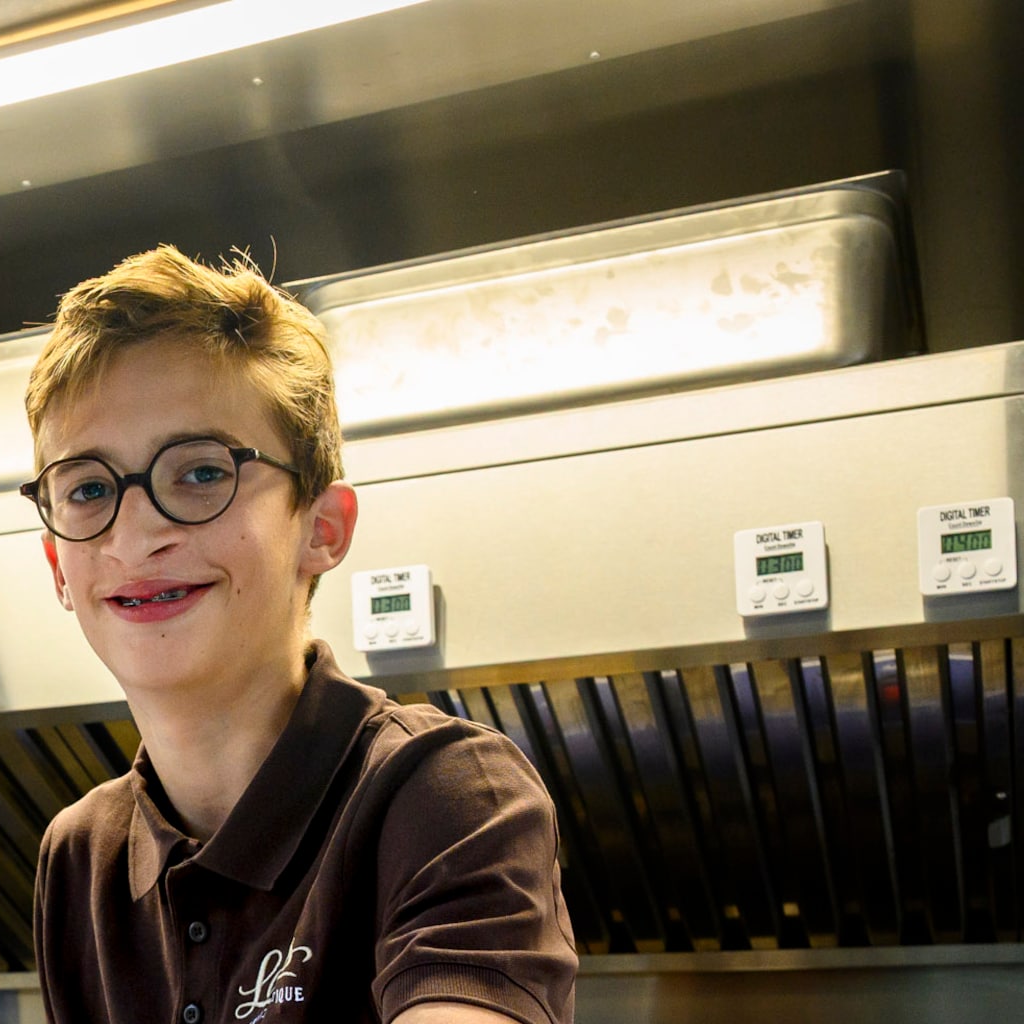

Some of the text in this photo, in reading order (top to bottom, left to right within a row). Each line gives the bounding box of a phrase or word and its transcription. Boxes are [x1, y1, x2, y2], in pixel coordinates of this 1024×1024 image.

[940, 507, 990, 521] DIGITAL TIMER
[756, 530, 803, 543] DIGITAL TIMER
